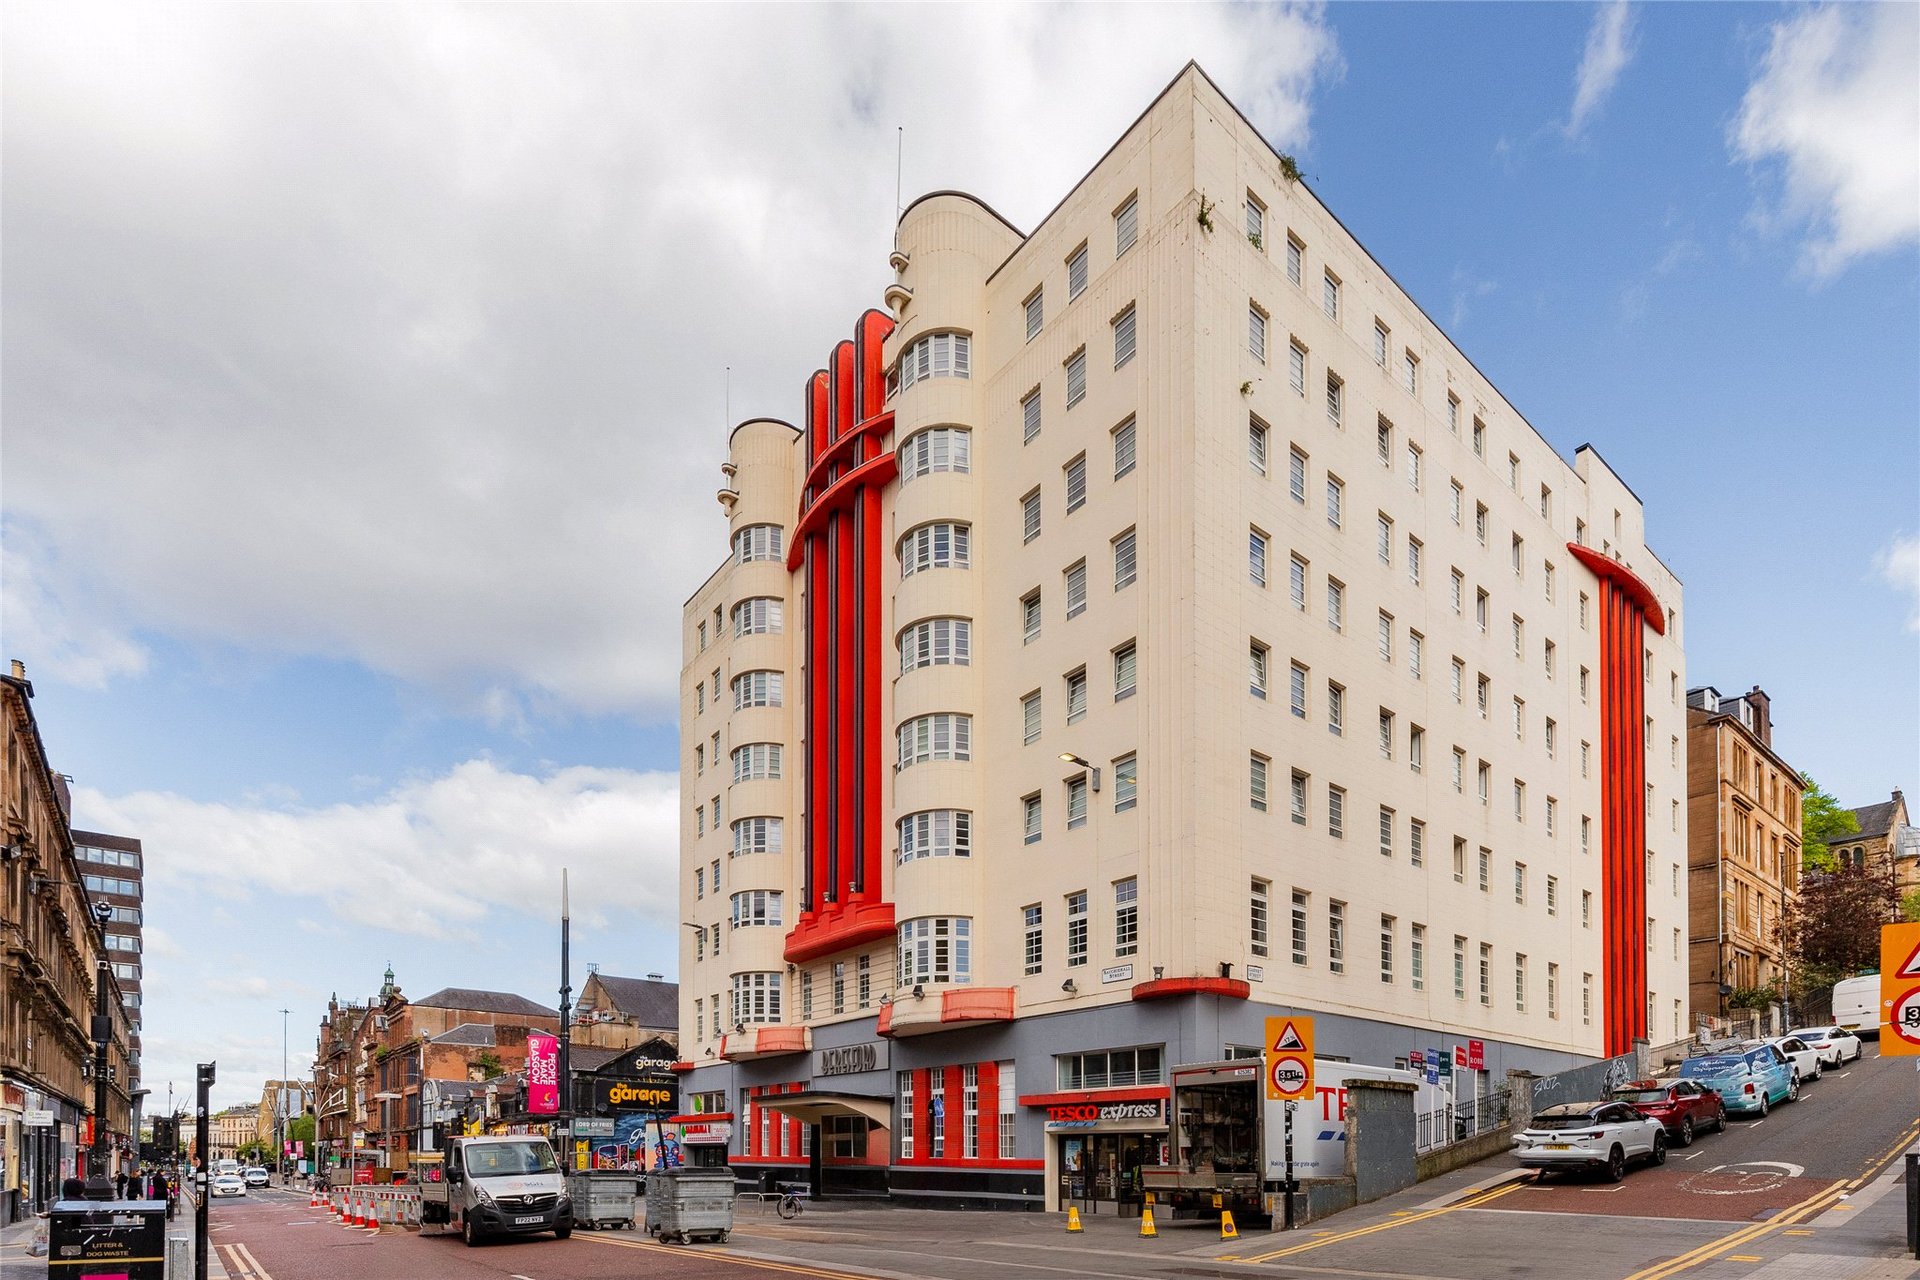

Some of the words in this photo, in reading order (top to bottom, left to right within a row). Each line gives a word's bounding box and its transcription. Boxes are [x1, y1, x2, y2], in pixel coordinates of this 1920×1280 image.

[530, 1039, 540, 1085] GLASGOW
[540, 1059, 548, 1086] MAKE
[548, 1052, 556, 1086] PEOPLE
[609, 1087, 671, 1106] garage
[1046, 1105, 1099, 1121] TESCO
[1100, 1103, 1157, 1122] express
[1270, 1160, 1284, 1168] Making
